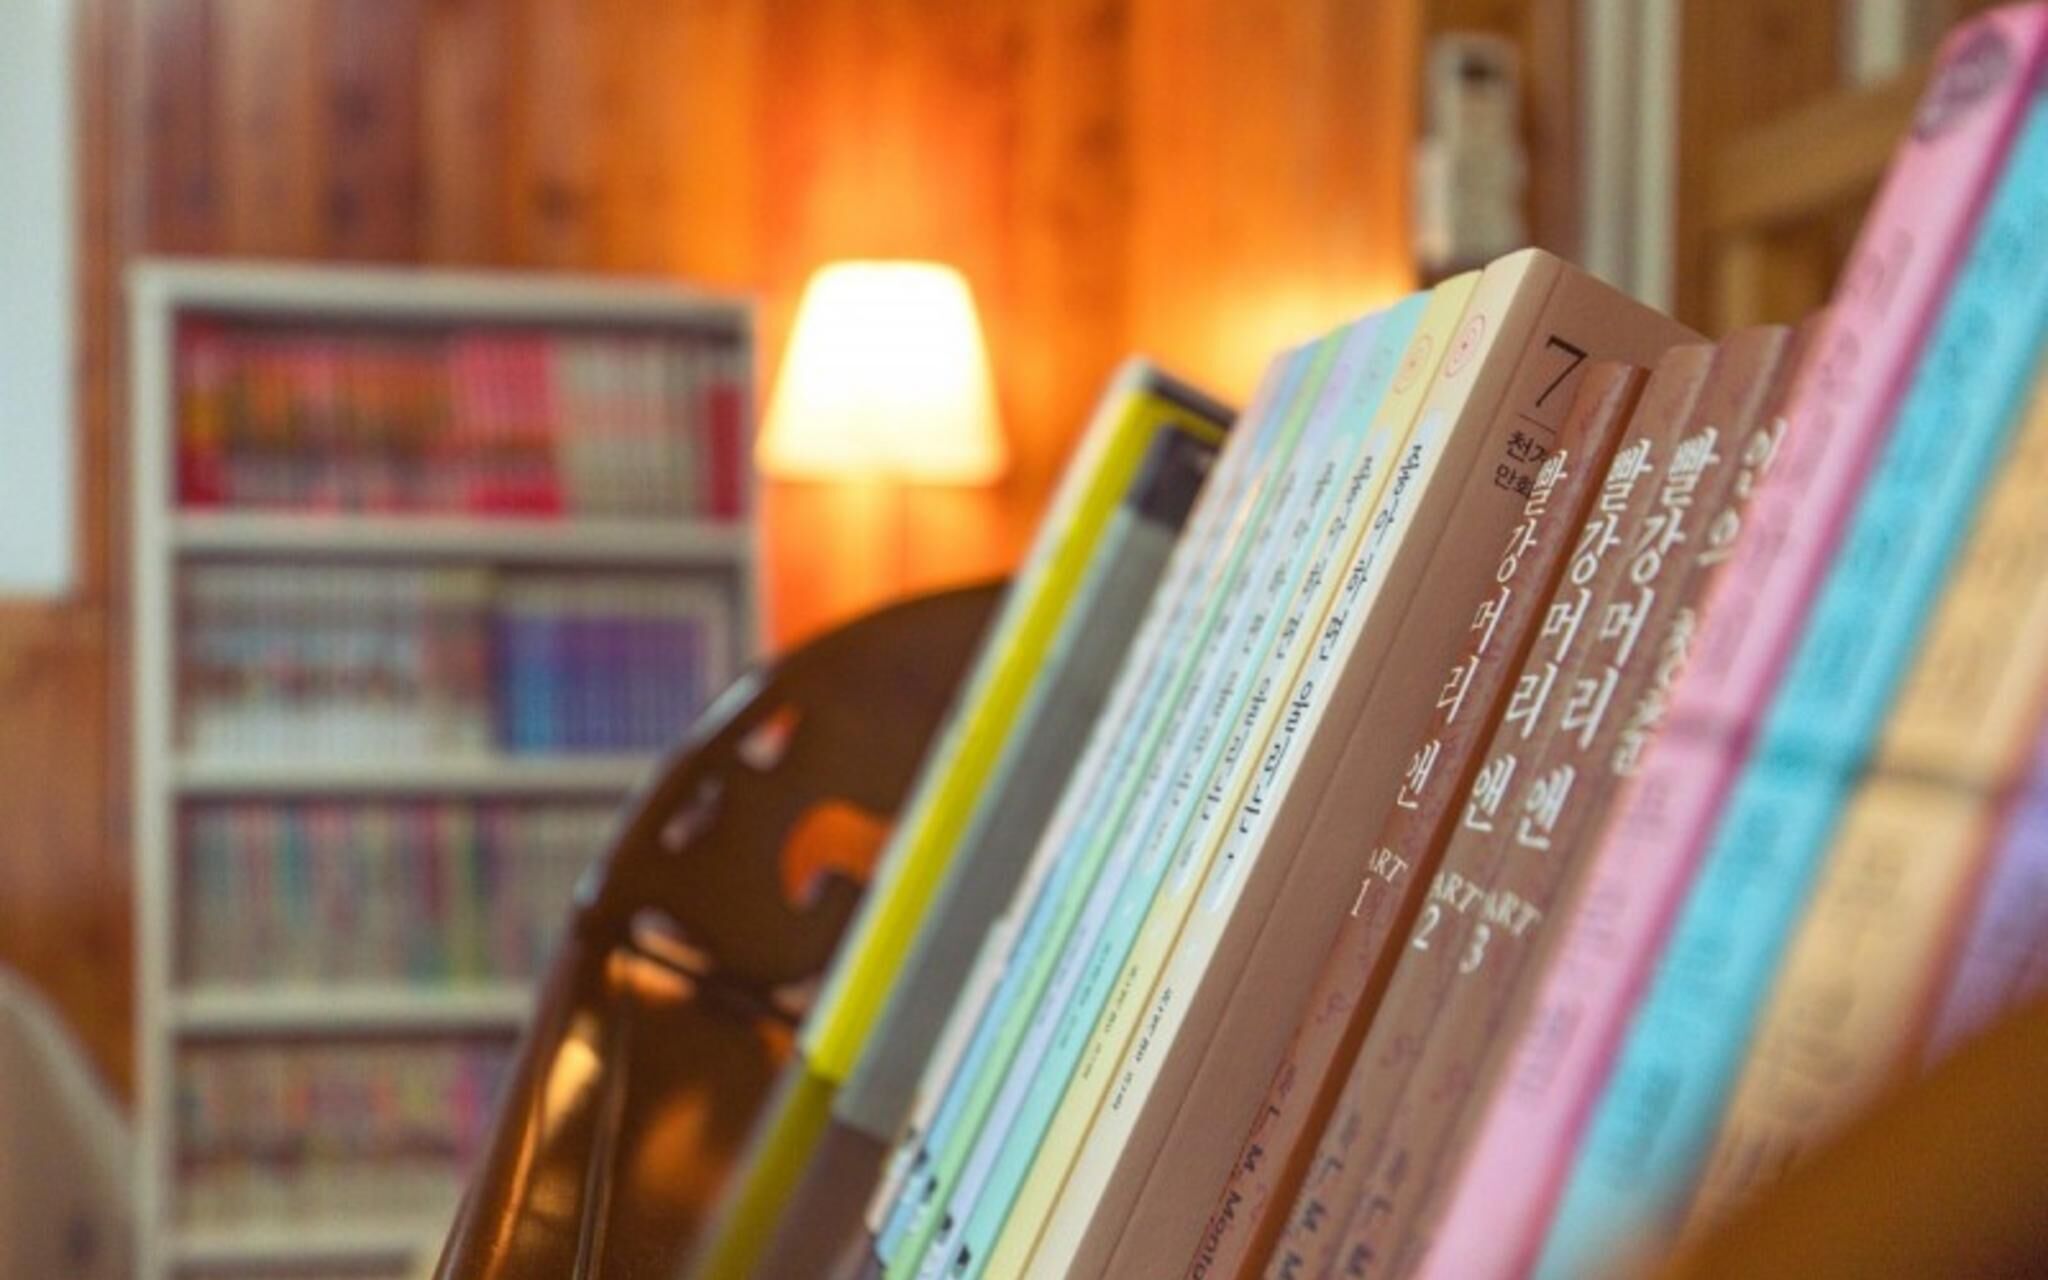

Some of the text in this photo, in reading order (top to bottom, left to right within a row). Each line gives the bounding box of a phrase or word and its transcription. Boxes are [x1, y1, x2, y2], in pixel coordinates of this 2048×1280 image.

[1546, 333, 1588, 408] 7
[1506, 438, 1652, 739] 빨강머리
[1562, 427, 1719, 749] 빨강머리
[1397, 449, 1567, 809] 빨강머리 앤
[1465, 753, 1517, 832] 앤
[1518, 765, 1574, 850] 앤
[1350, 878, 1372, 918] 1
[1413, 904, 1441, 950] 2
[1459, 924, 1491, 973] 3
